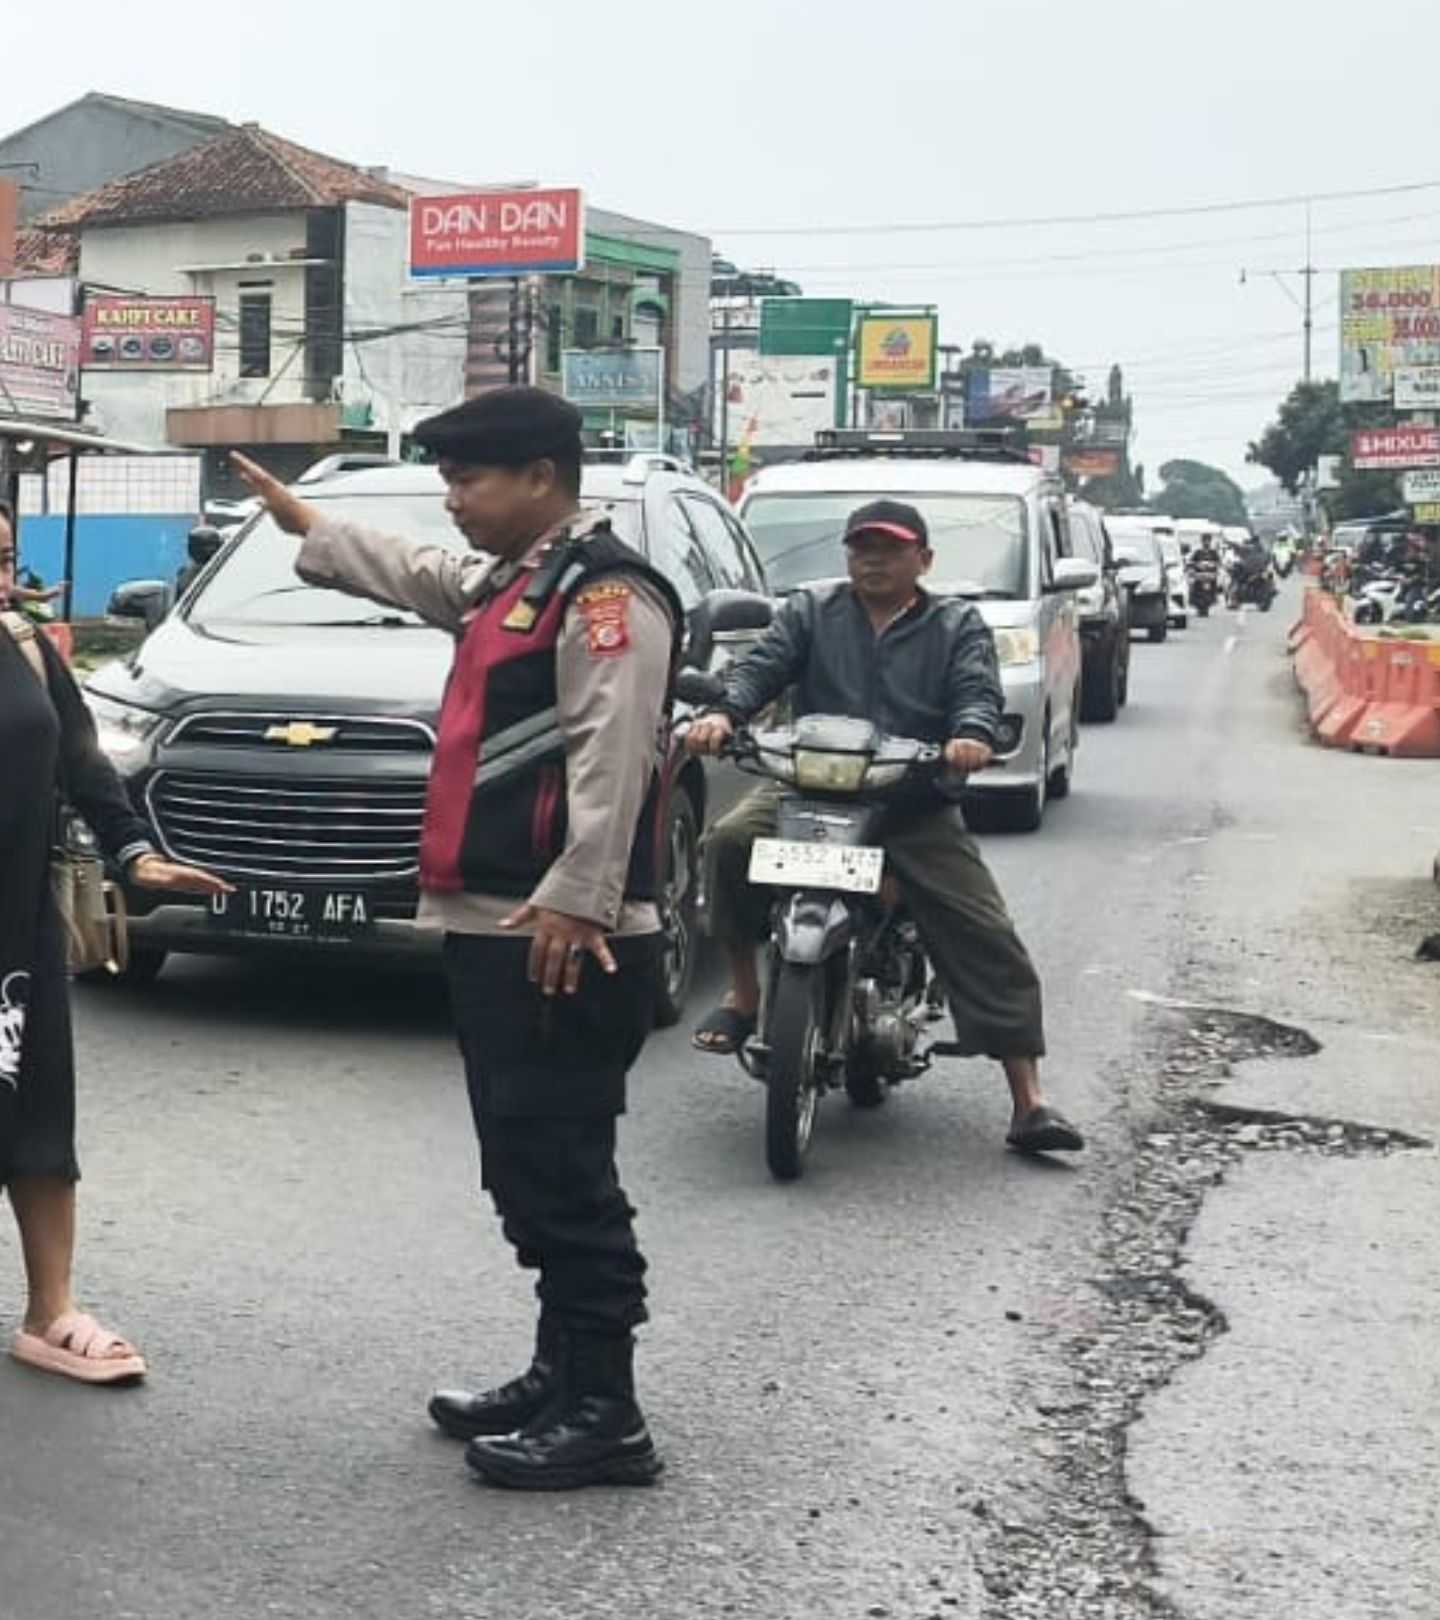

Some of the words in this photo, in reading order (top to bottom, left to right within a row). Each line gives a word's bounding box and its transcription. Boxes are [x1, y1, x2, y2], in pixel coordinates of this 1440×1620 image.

[422, 204, 486, 235] DAN
[500, 201, 567, 232] DAN
[154, 309, 199, 325] CAKE
[250, 890, 305, 918] 1752
[323, 893, 367, 923] AFA
